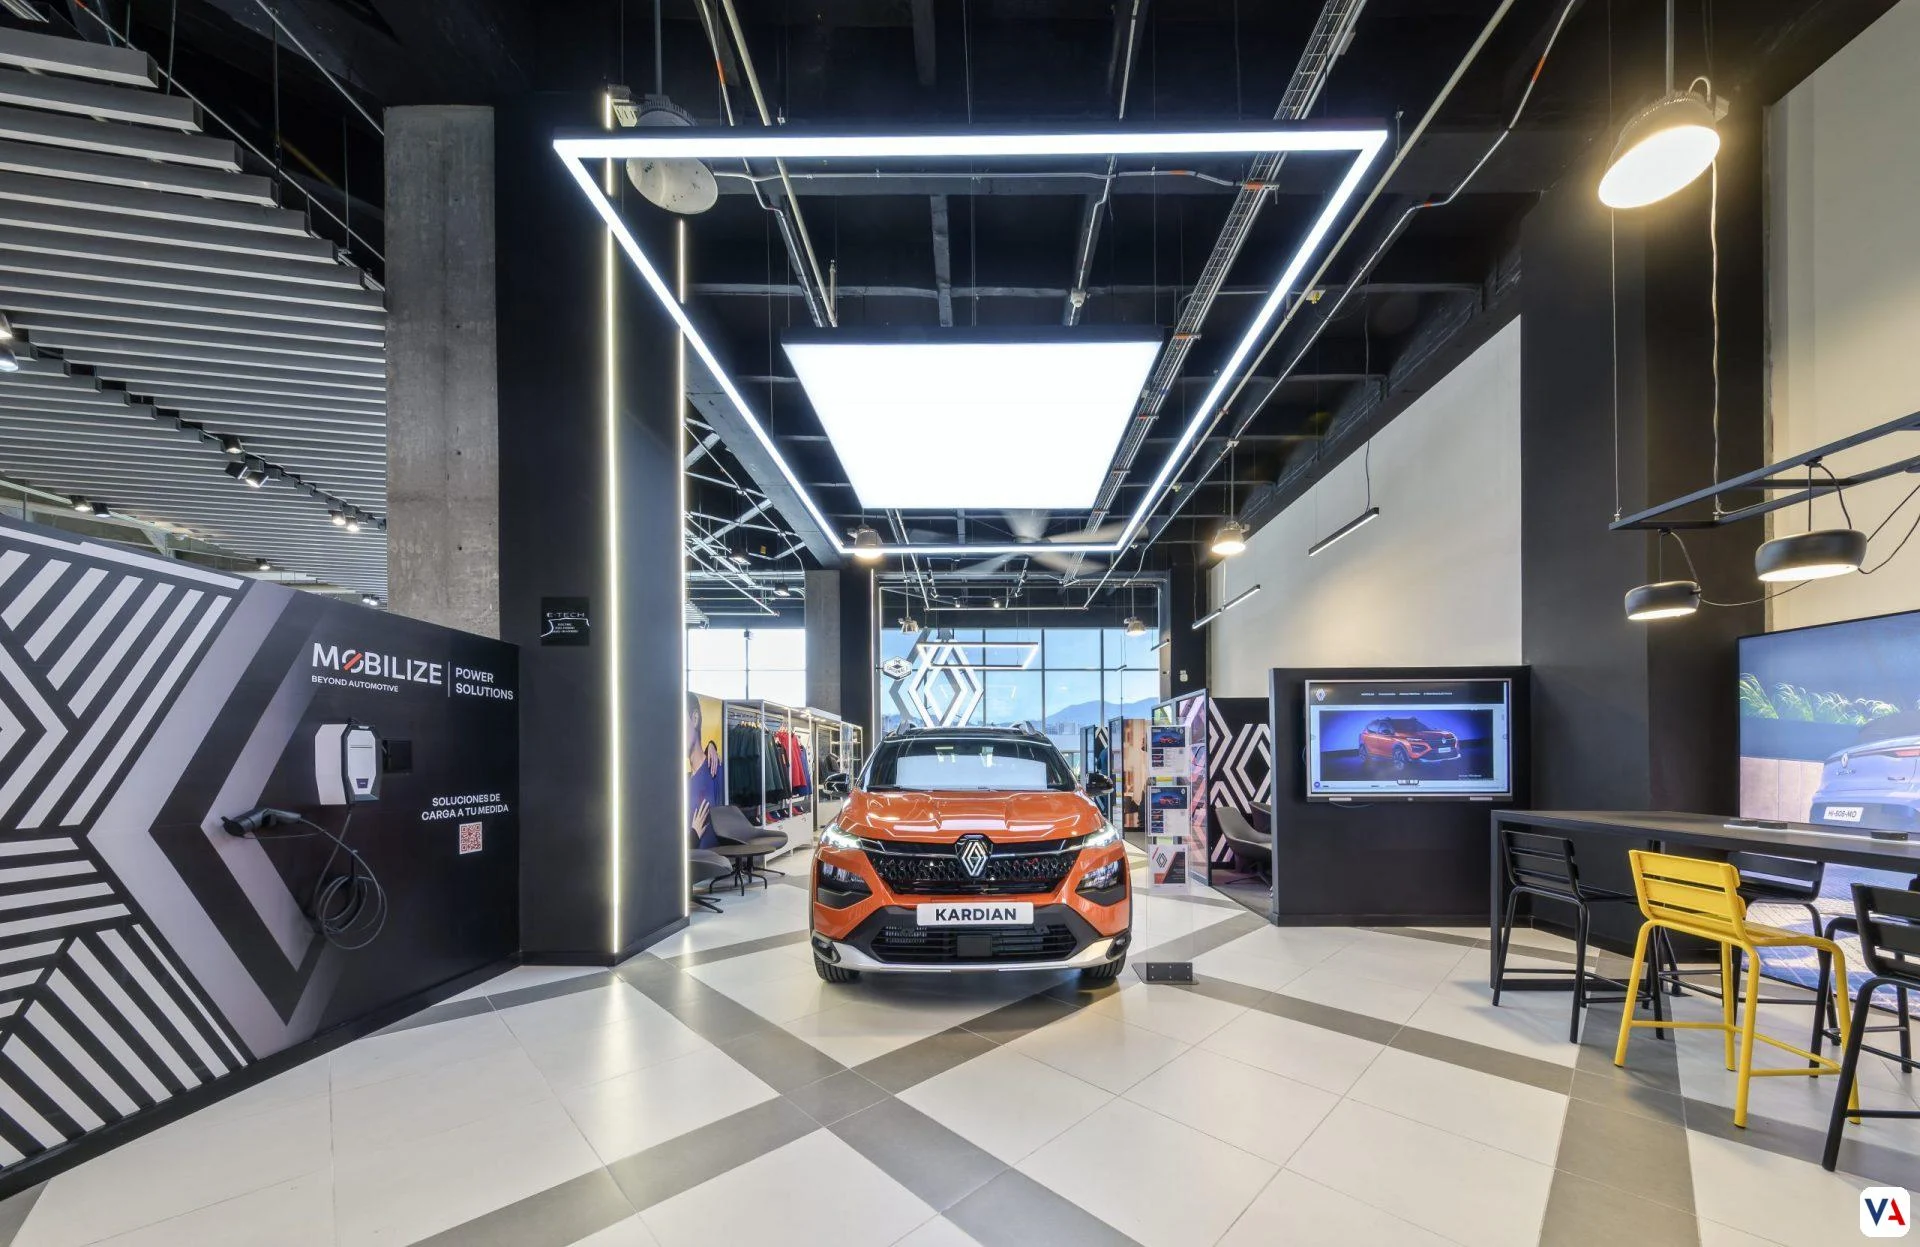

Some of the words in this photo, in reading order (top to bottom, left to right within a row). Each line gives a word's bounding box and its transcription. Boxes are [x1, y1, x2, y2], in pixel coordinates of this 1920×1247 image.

[312, 643, 442, 685] MOBILIZE
[455, 667, 494, 683] POWER
[311, 675, 348, 686] BEYOND
[348, 680, 399, 693] AUTOMOTIVE
[455, 683, 514, 700] SOLUTIONS
[432, 794, 489, 806] SOLUCIONES
[489, 793, 501, 802] DE
[421, 809, 456, 821] CARGA
[457, 808, 464, 817] A
[465, 806, 477, 816] TU
[477, 804, 509, 815] MEDIDA
[935, 908, 1017, 921] KARDIAN
